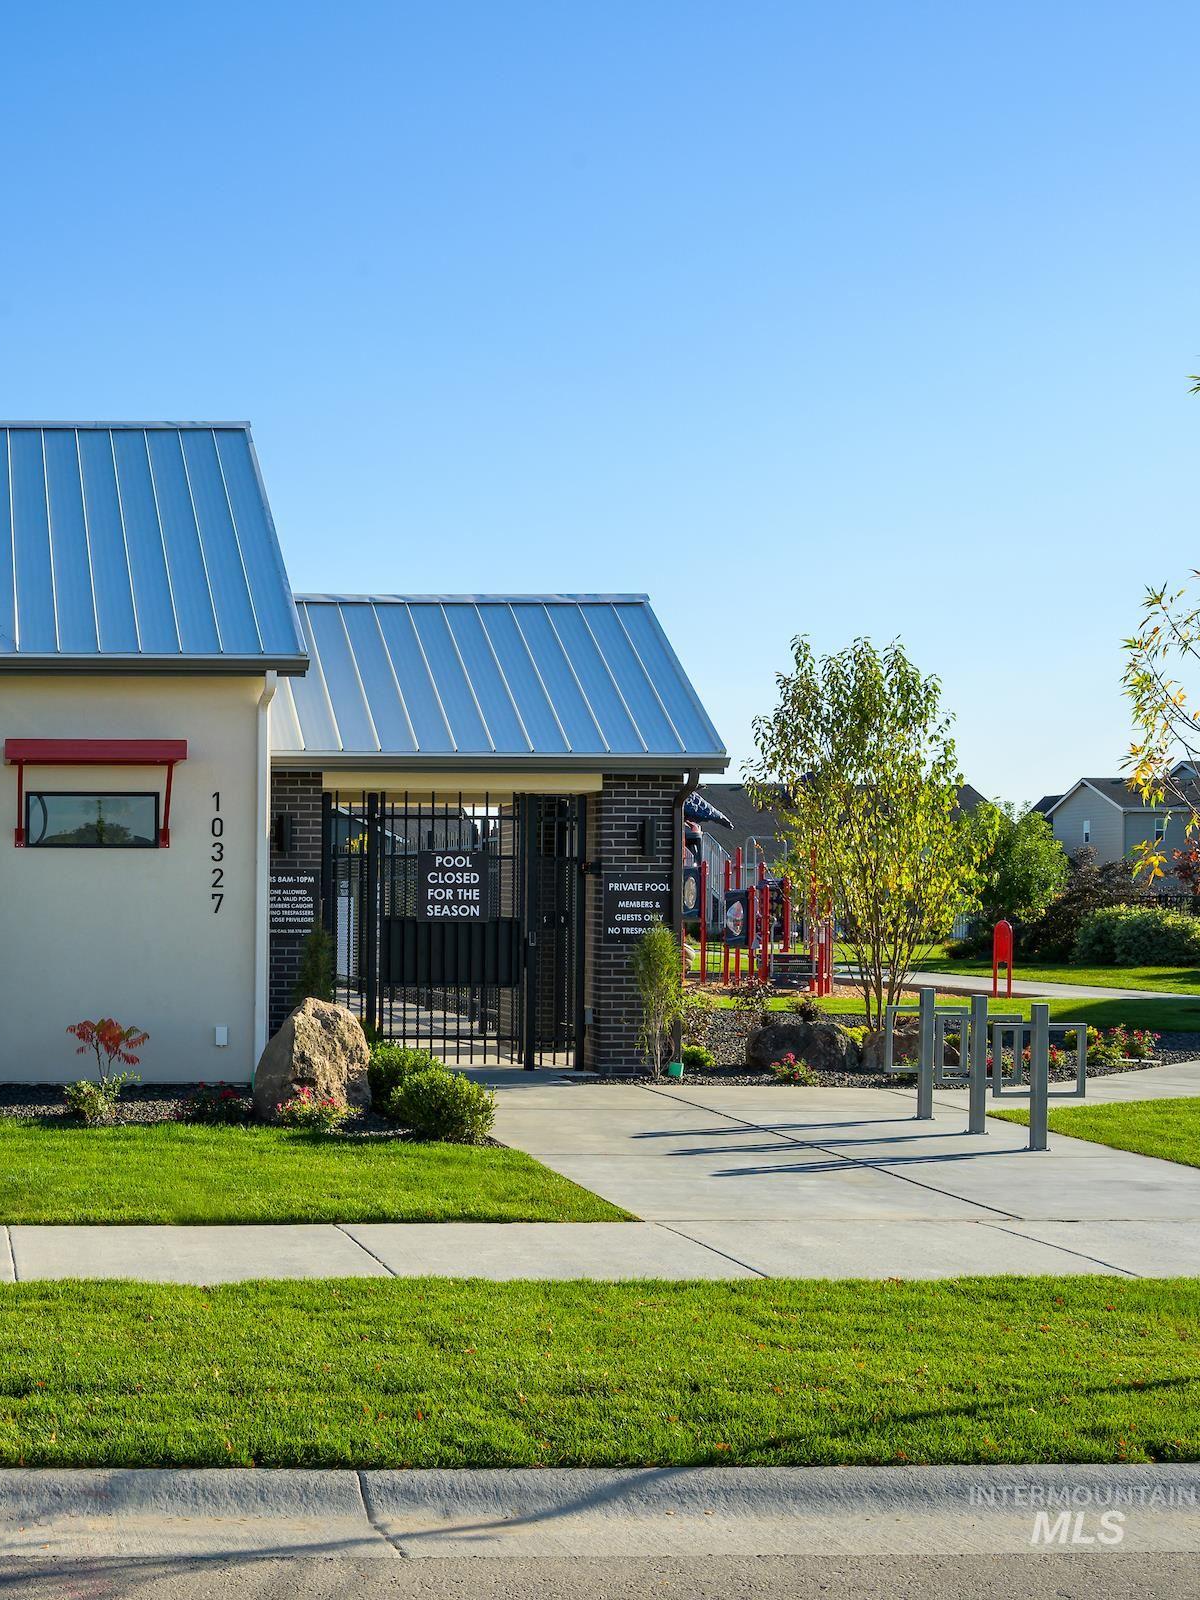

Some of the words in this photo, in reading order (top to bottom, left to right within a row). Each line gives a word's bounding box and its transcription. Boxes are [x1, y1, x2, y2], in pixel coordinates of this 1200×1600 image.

[211, 791, 224, 914] 10327
[435, 856, 473, 868] POOL
[427, 872, 480, 884] CLOSED
[608, 883, 643, 891] PRIVATE
[645, 883, 670, 891] POOL
[427, 888, 454, 900] FOR
[456, 888, 480, 900] THE
[618, 900, 653, 908] MEMBERS
[426, 904, 480, 917] SEASON
[608, 927, 621, 935] NO
